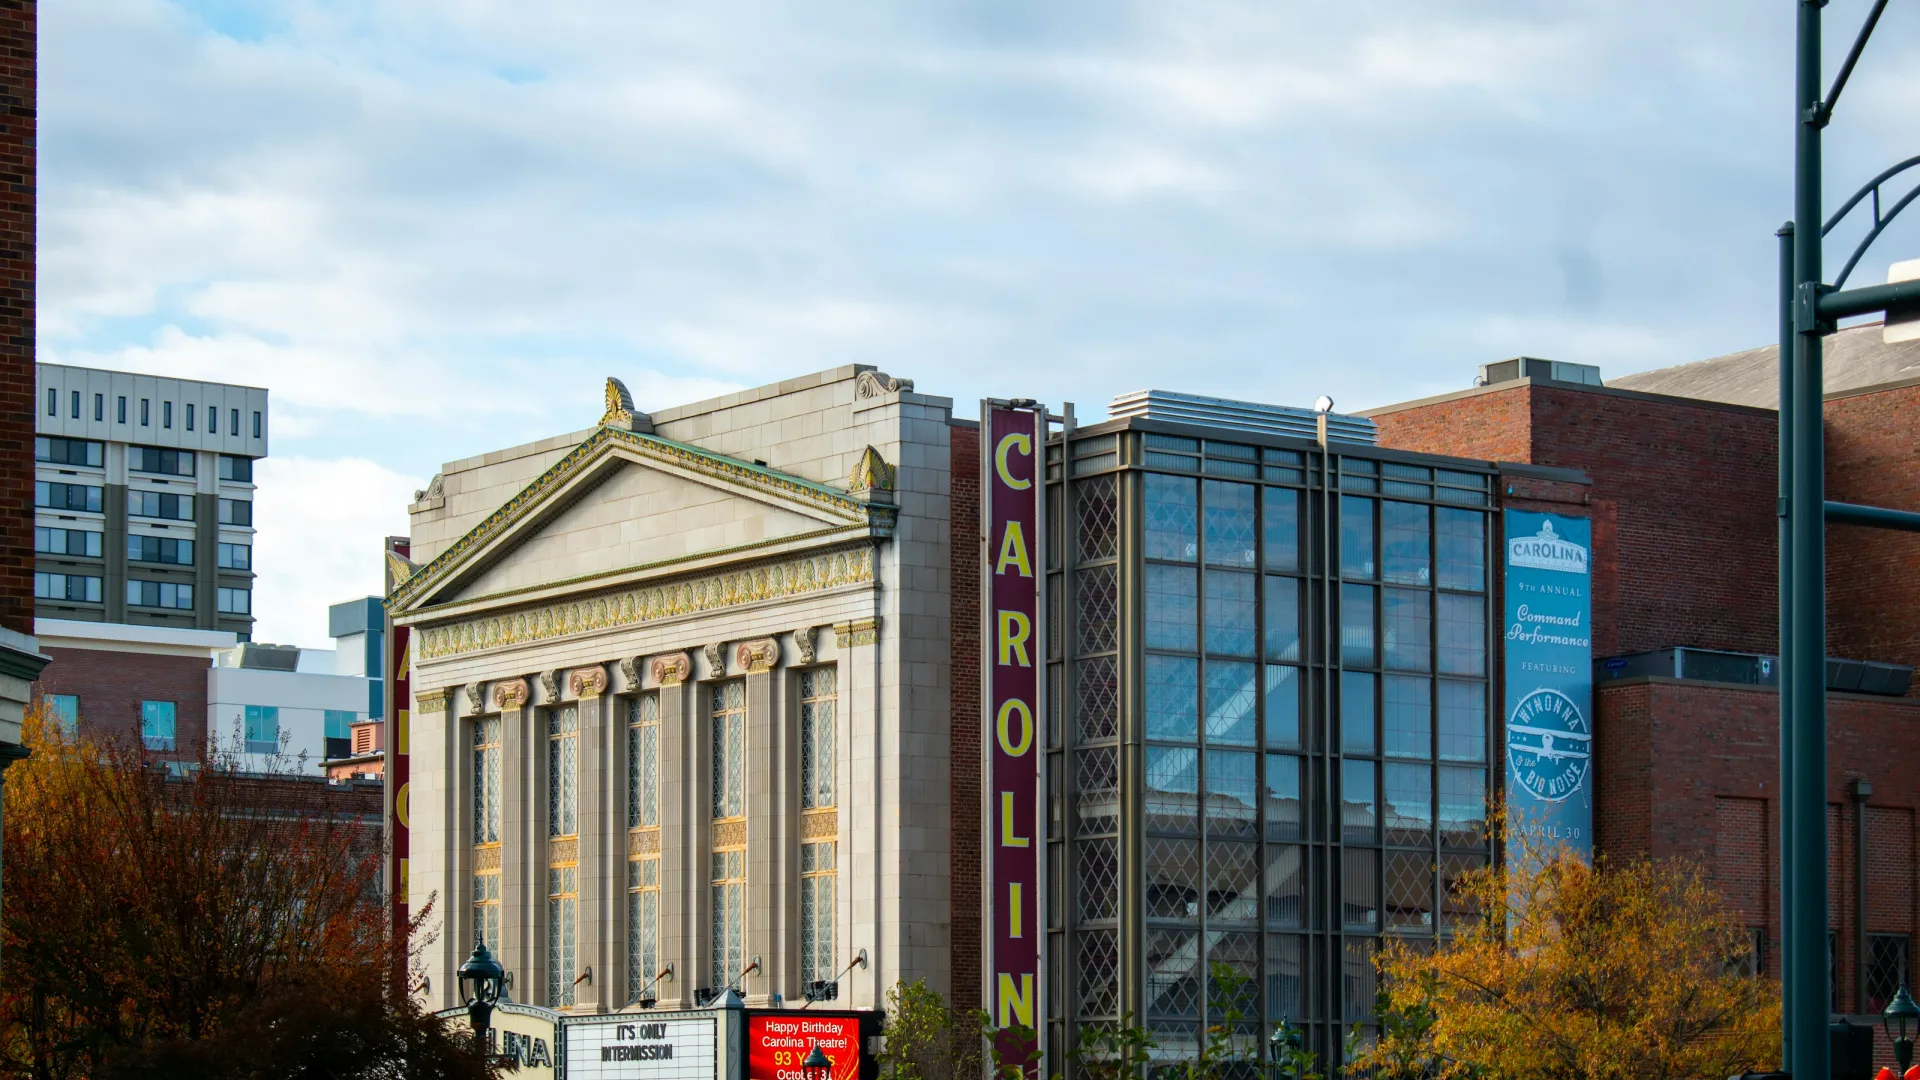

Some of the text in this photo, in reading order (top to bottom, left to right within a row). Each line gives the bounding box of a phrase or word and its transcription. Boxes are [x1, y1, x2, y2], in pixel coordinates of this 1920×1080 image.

[1513, 543, 1583, 562] CAROLINA
[1519, 582, 1581, 597] 9TH ANNUAL
[1517, 604, 1580, 627] Command
[1507, 623, 1589, 647] Performance
[1522, 661, 1576, 675] FEATURING
[1518, 695, 1579, 731] WYNONNA
[995, 432, 1034, 1080] CAROLIN
[1549, 762, 1581, 796] NOISE
[1520, 824, 1580, 839] APRIL 30
[617, 1023, 667, 1041] IT'S ONLY
[765, 1021, 844, 1036] Happy Birthday
[761, 1036, 805, 1048] Carolina
[774, 1051, 792, 1066] 93
